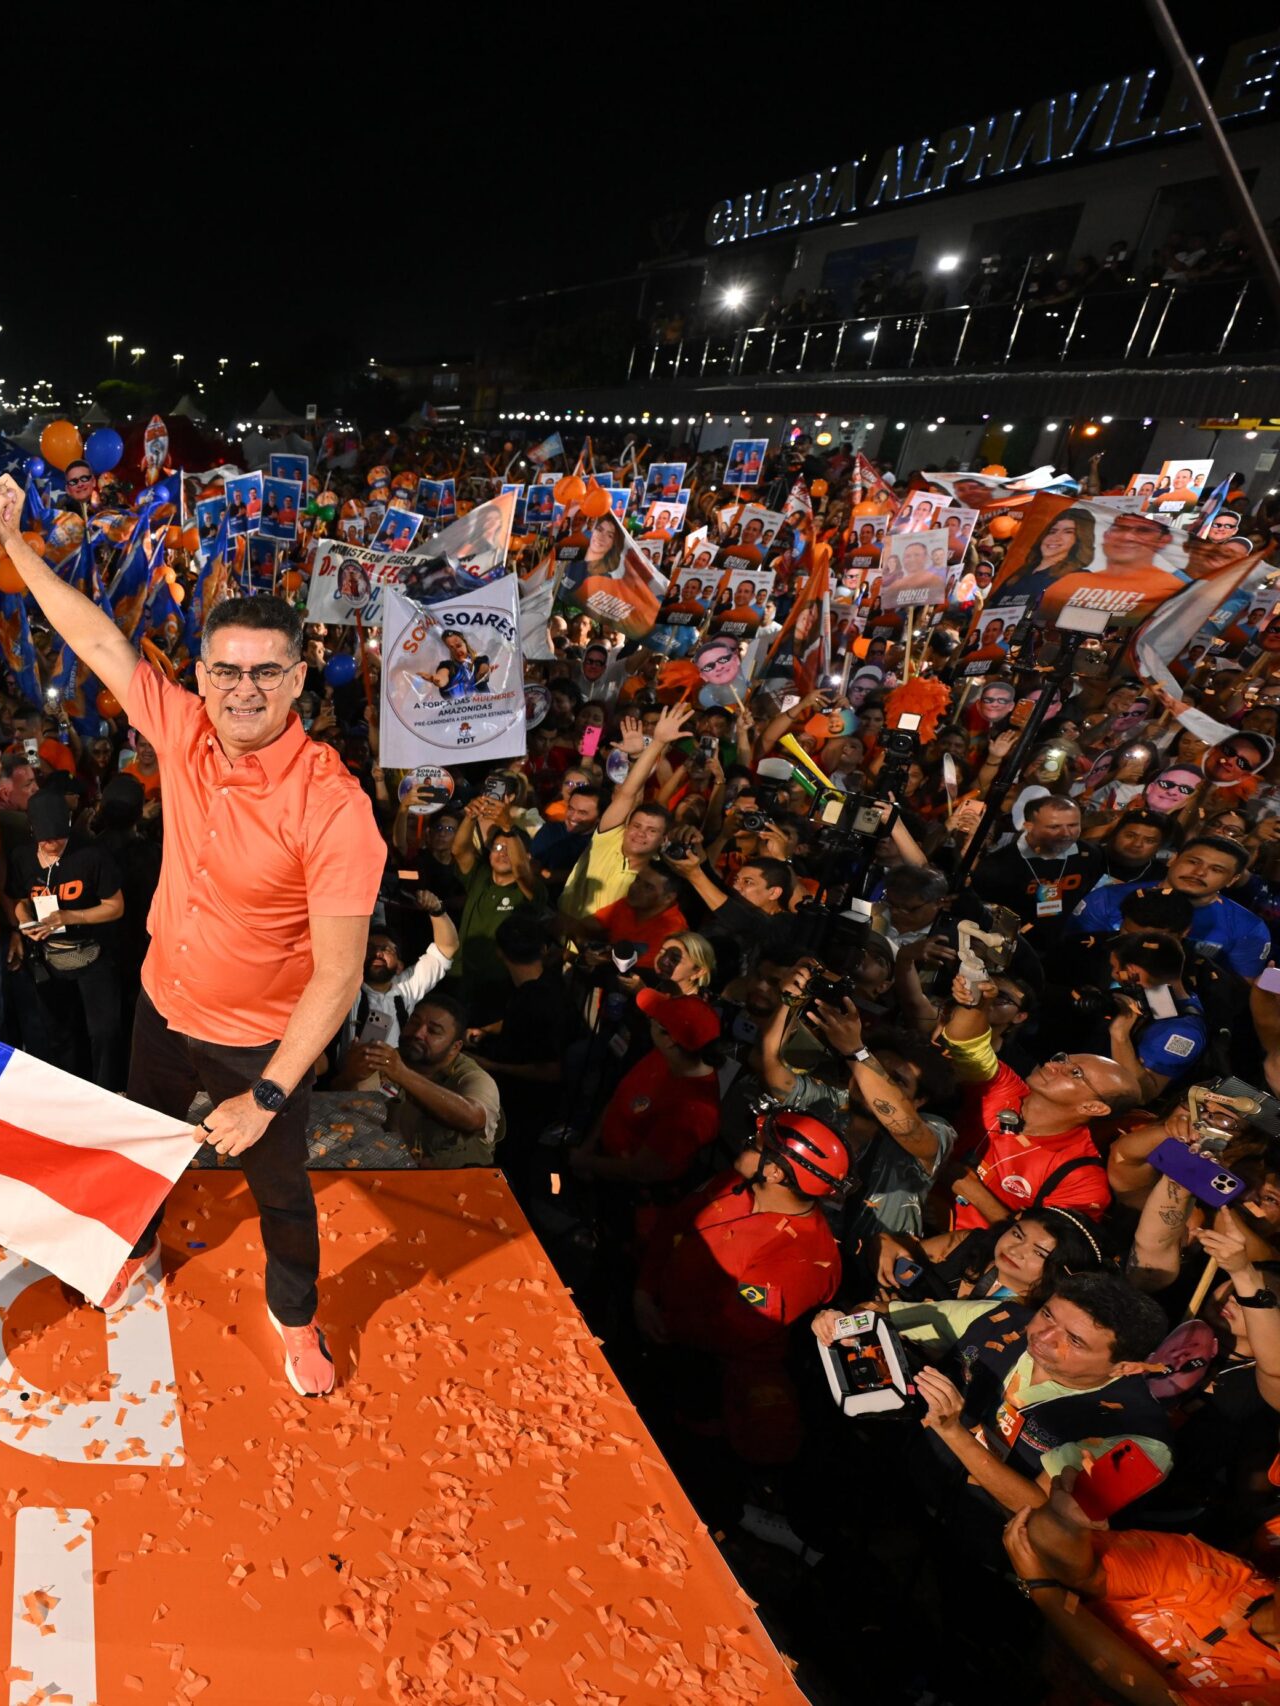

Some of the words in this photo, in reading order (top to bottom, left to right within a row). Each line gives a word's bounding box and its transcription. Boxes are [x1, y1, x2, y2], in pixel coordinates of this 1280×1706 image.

[704, 160, 862, 246] GALERIA
[1070, 587, 1146, 604] DANIEL
[438, 702, 493, 717] AMAZONIDAS
[457, 736, 476, 745] PDT
